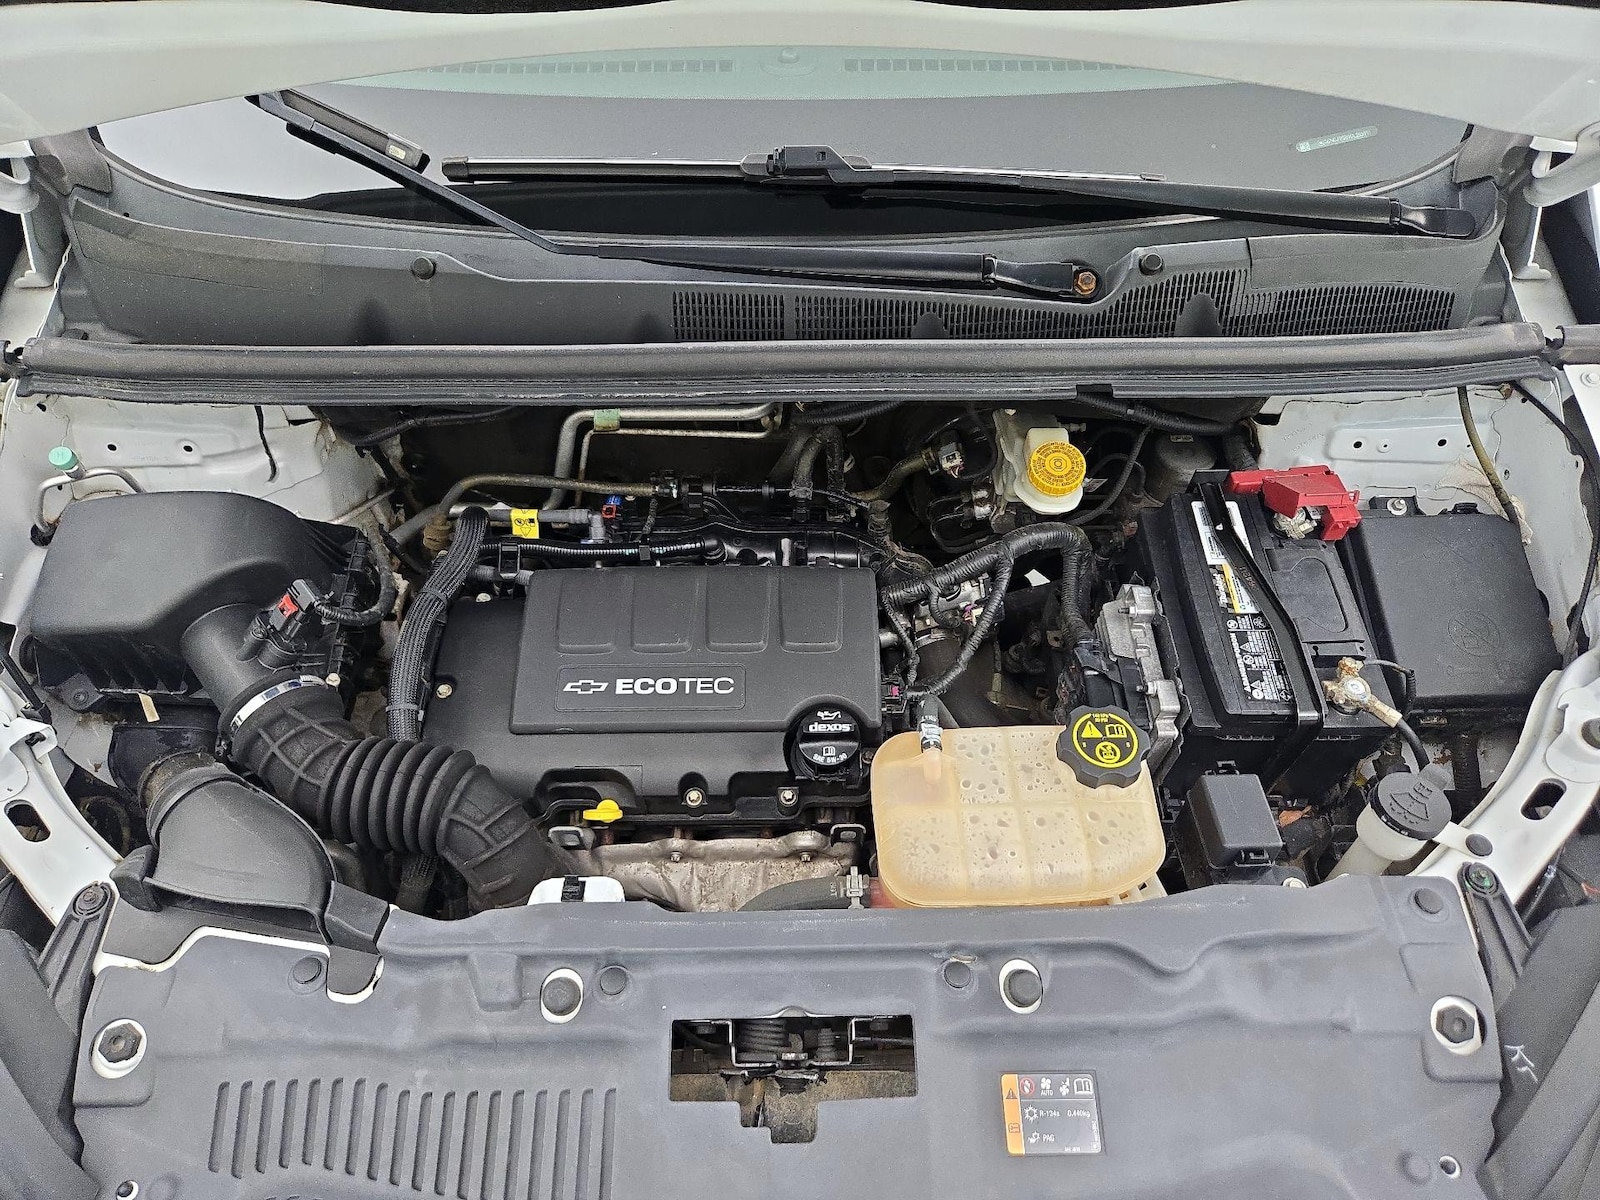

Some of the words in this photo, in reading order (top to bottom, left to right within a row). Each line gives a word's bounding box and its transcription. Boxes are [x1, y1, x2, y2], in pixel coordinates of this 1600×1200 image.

[615, 677, 735, 695] ECOTEC
[809, 722, 850, 732] dexos
[812, 753, 825, 763] SAE
[826, 753, 848, 763] 5W-30
[1039, 1109, 1060, 1117] R-134a
[1042, 1134, 1055, 1142] PAG
